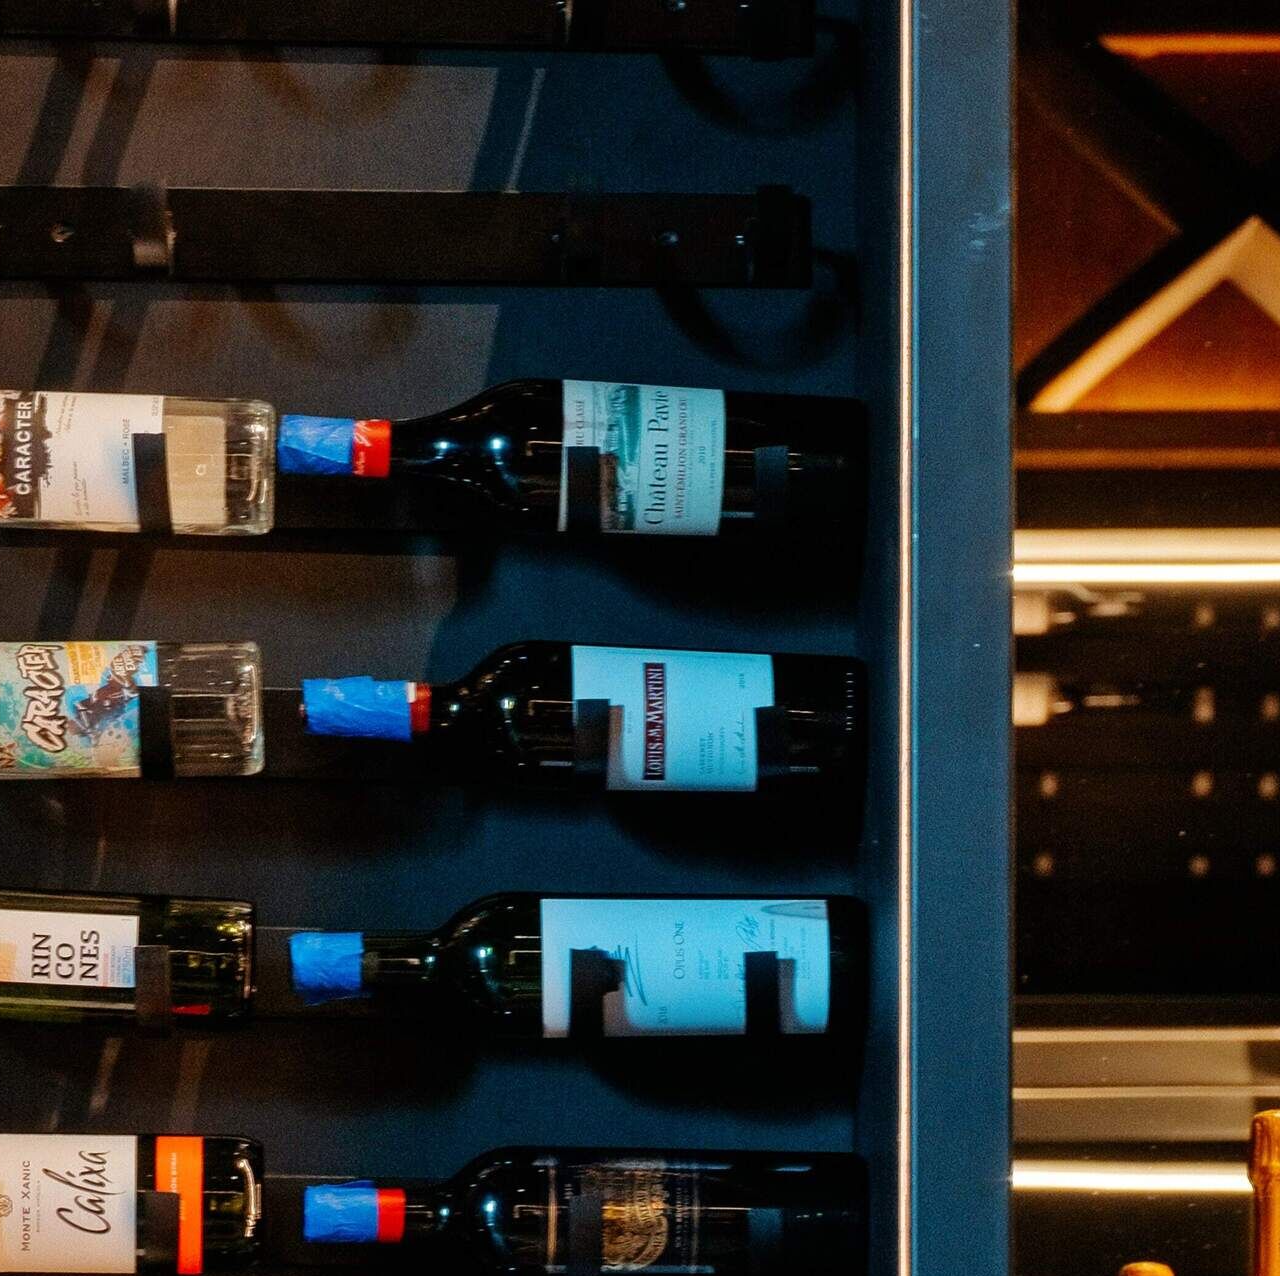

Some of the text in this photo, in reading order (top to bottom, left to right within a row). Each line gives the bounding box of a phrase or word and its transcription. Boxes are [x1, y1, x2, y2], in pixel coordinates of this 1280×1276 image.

[646, 389, 670, 432] Pavie
[14, 400, 33, 496] CARACTER
[121, 448, 131, 485] MALBEC
[15, 643, 68, 753] CARACTER
[645, 667, 665, 724] MARTINI
[646, 742, 665, 776] LOUIS
[31, 932, 51, 979] RIN
[54, 943, 75, 980] CO
[79, 929, 100, 982] NES
[20, 1160, 32, 1252] MONTE XANIC
[42, 1150, 127, 1236] Calixa
